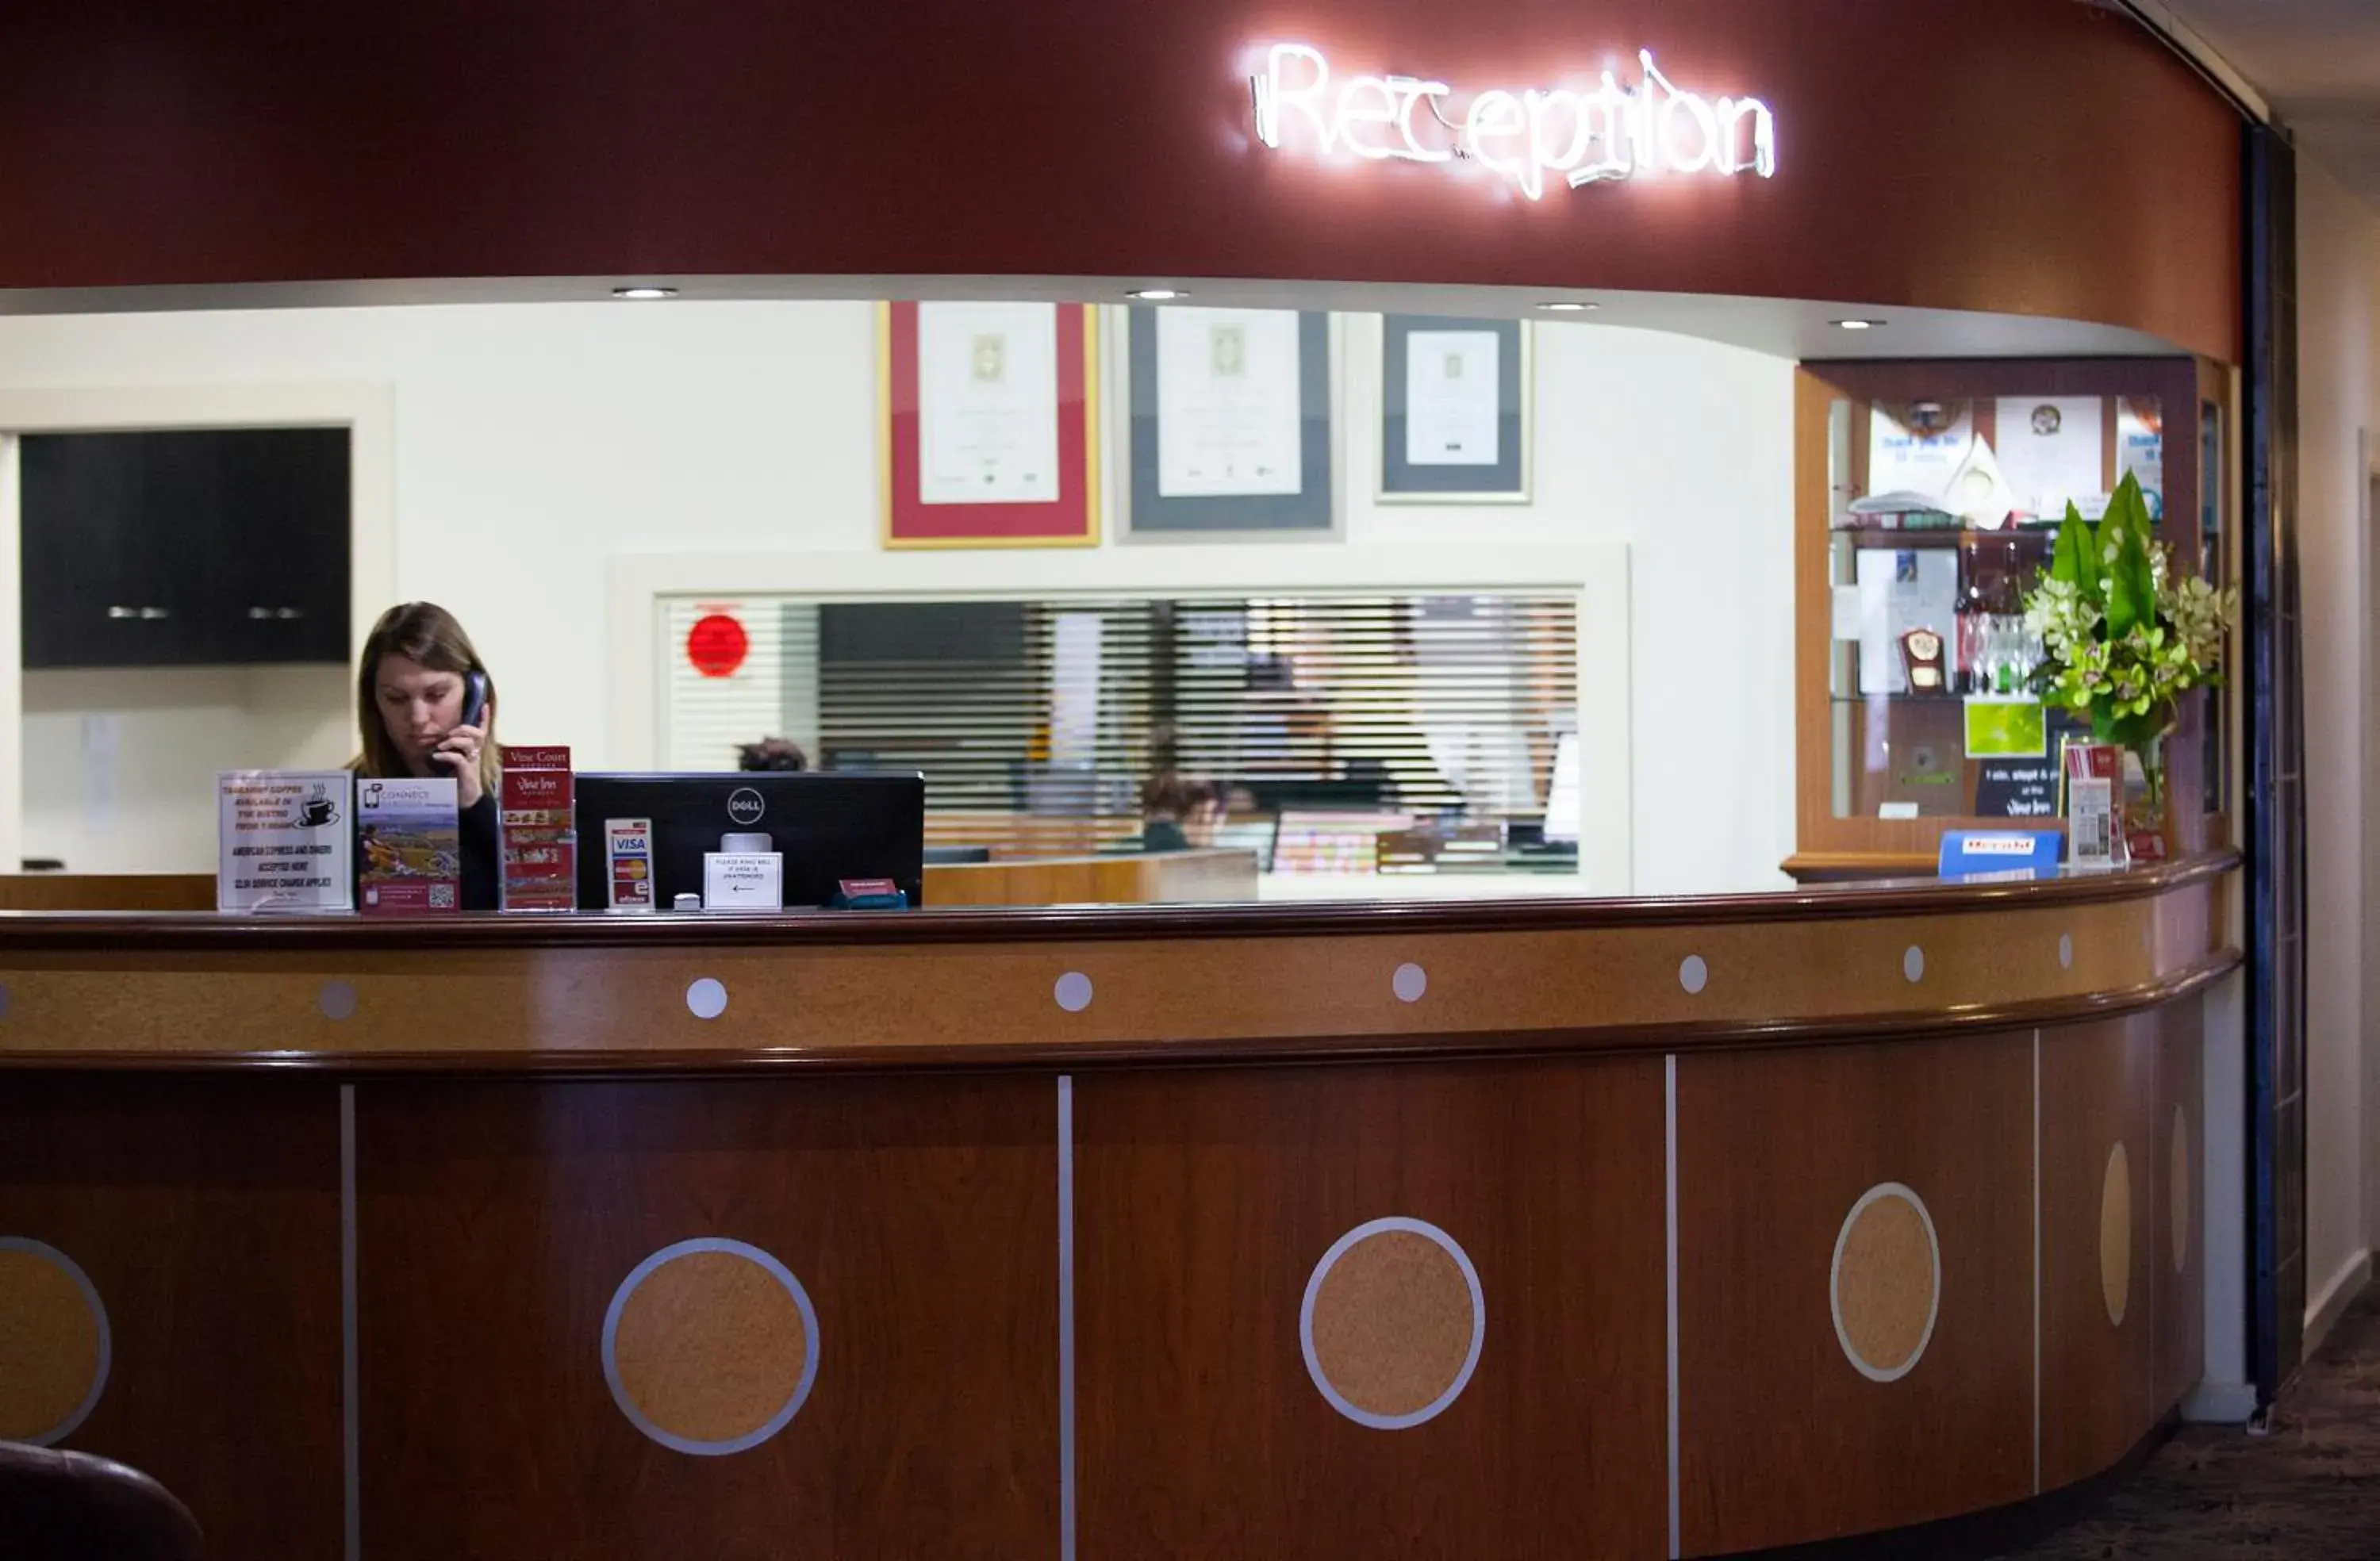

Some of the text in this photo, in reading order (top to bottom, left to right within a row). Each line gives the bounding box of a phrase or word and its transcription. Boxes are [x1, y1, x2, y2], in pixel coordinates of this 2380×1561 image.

[1251, 43, 1775, 198] Reception
[537, 751, 566, 761] Court
[540, 777, 556, 789] Inn
[381, 791, 428, 800] CONNECT
[732, 800, 760, 810] DELL
[617, 838, 645, 849] VISA
[232, 846, 263, 856] AMERICAN
[266, 845, 294, 855] EXPRESS
[295, 845, 307, 854] AND
[258, 861, 309, 872] ACCEPTED HERE
[252, 879, 278, 888] SERVICE
[280, 878, 305, 888] CHARGE
[305, 878, 332, 887] APPLIES
